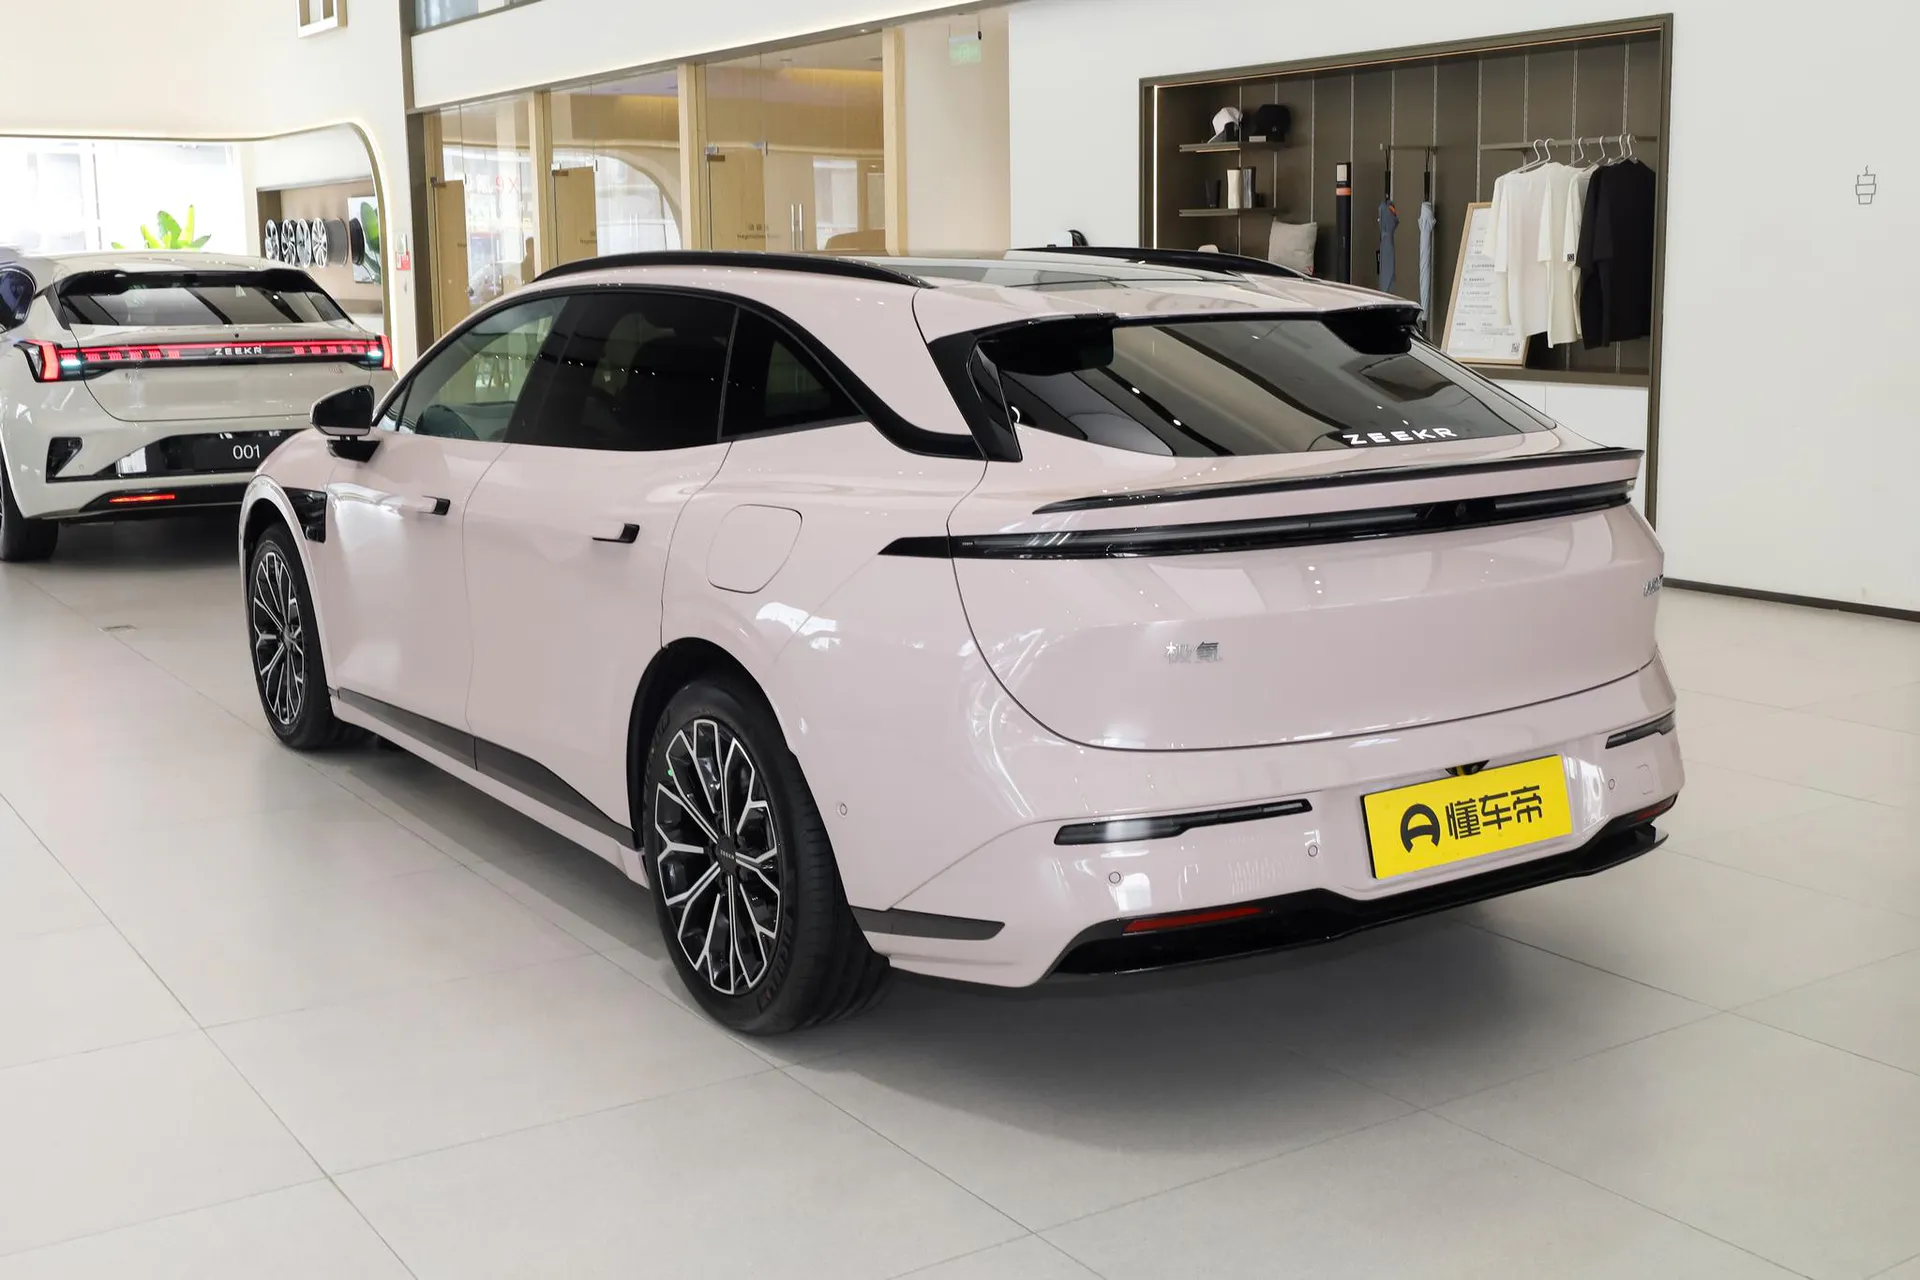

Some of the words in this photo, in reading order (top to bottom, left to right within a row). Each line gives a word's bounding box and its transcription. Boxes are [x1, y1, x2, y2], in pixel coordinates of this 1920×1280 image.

[214, 345, 262, 356] ZEEKR
[1342, 427, 1458, 445] ZEEKR
[232, 444, 261, 460] 001
[1445, 784, 1543, 840] 懂车帝
